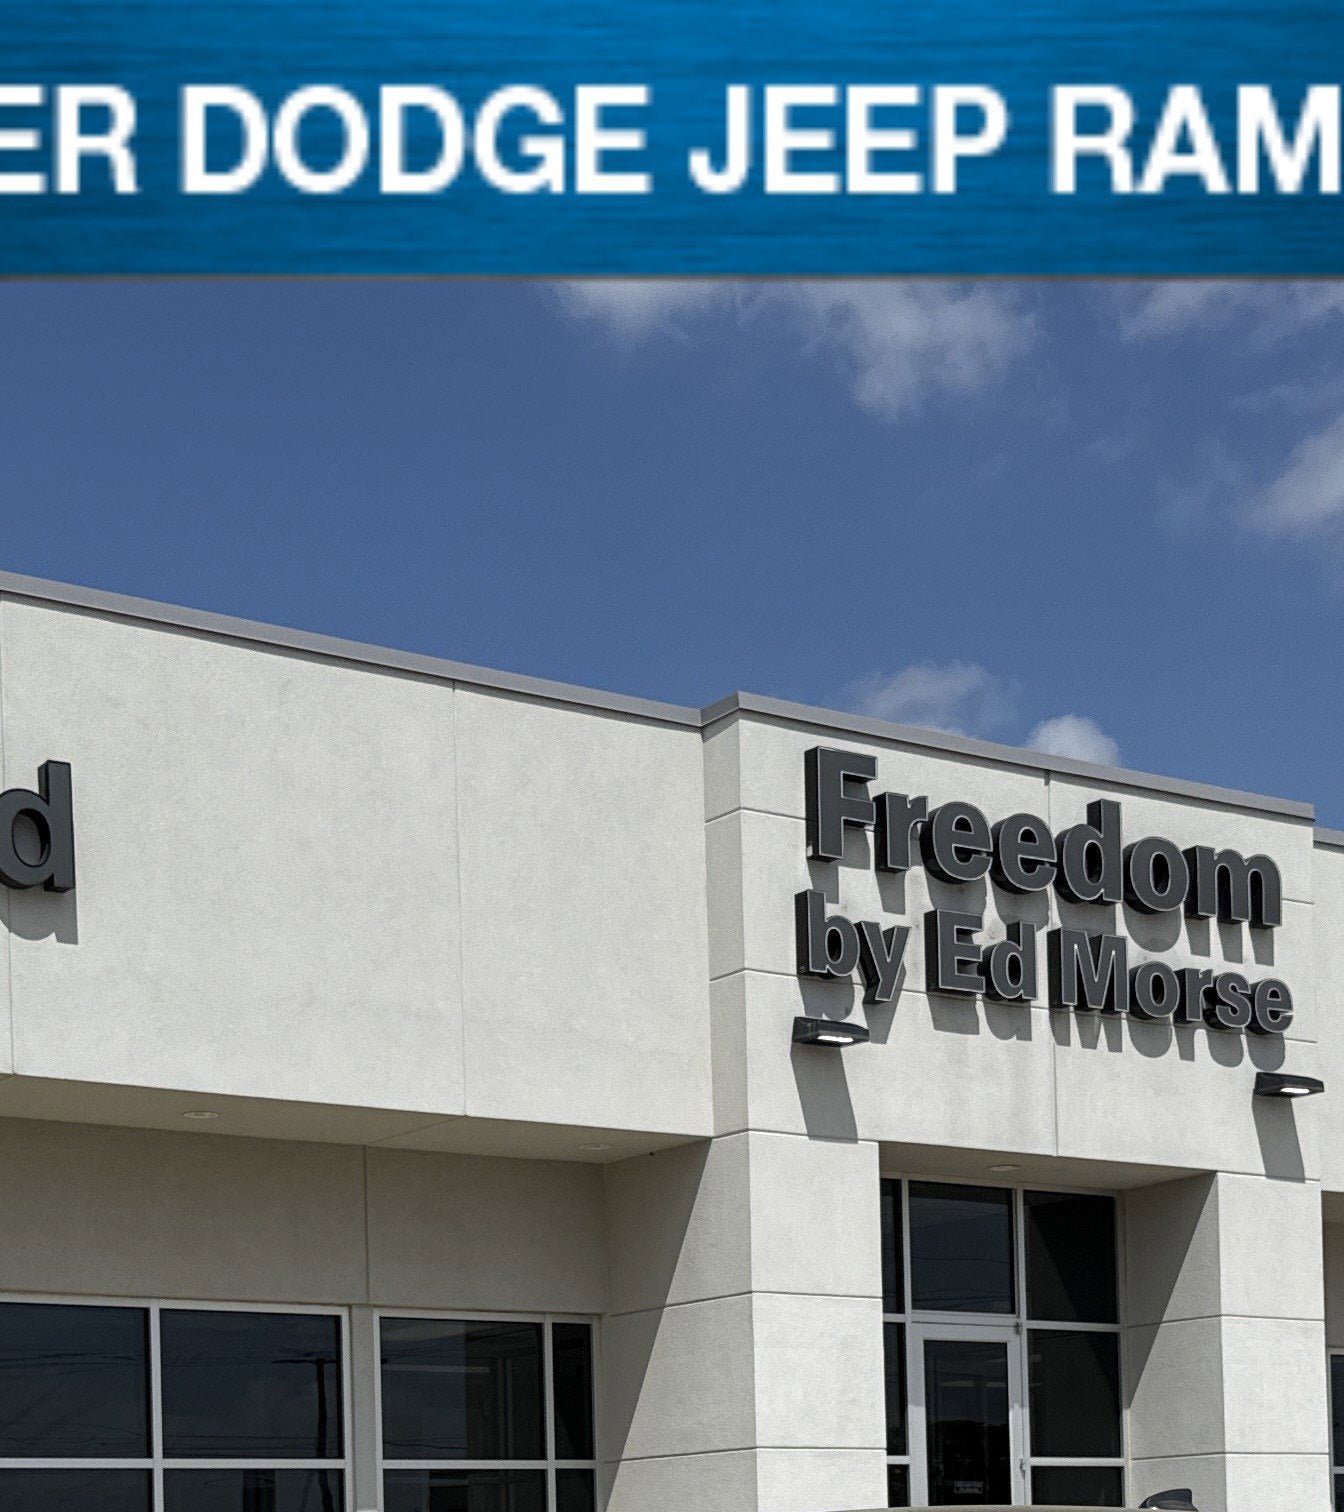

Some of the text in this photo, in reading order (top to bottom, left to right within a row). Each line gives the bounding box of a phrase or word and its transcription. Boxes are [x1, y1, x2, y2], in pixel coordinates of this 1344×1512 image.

[803, 745, 1283, 930] Freedom
[794, 889, 1294, 1036] by Ed Morse
